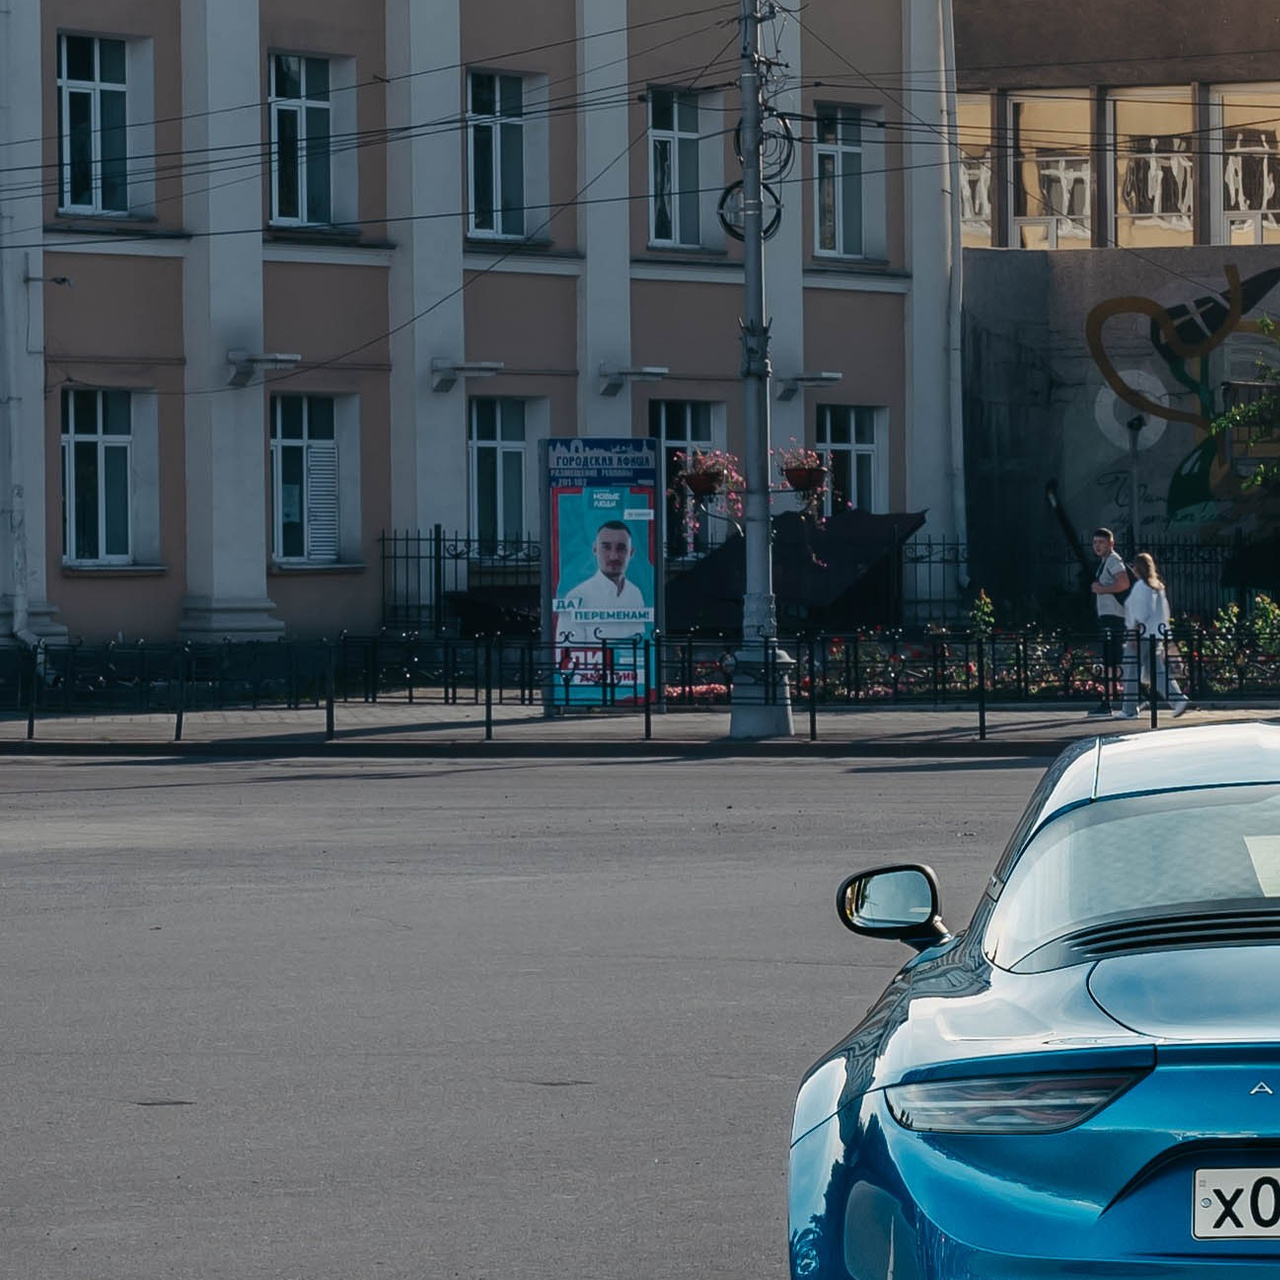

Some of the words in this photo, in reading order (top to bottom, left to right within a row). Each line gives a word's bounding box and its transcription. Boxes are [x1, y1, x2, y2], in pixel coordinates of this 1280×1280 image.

[556, 455, 613, 467] ГОРОДСКАЯ
[617, 455, 651, 466] АФИША
[574, 610, 650, 620] ПЕРЕМЕНАМ!
